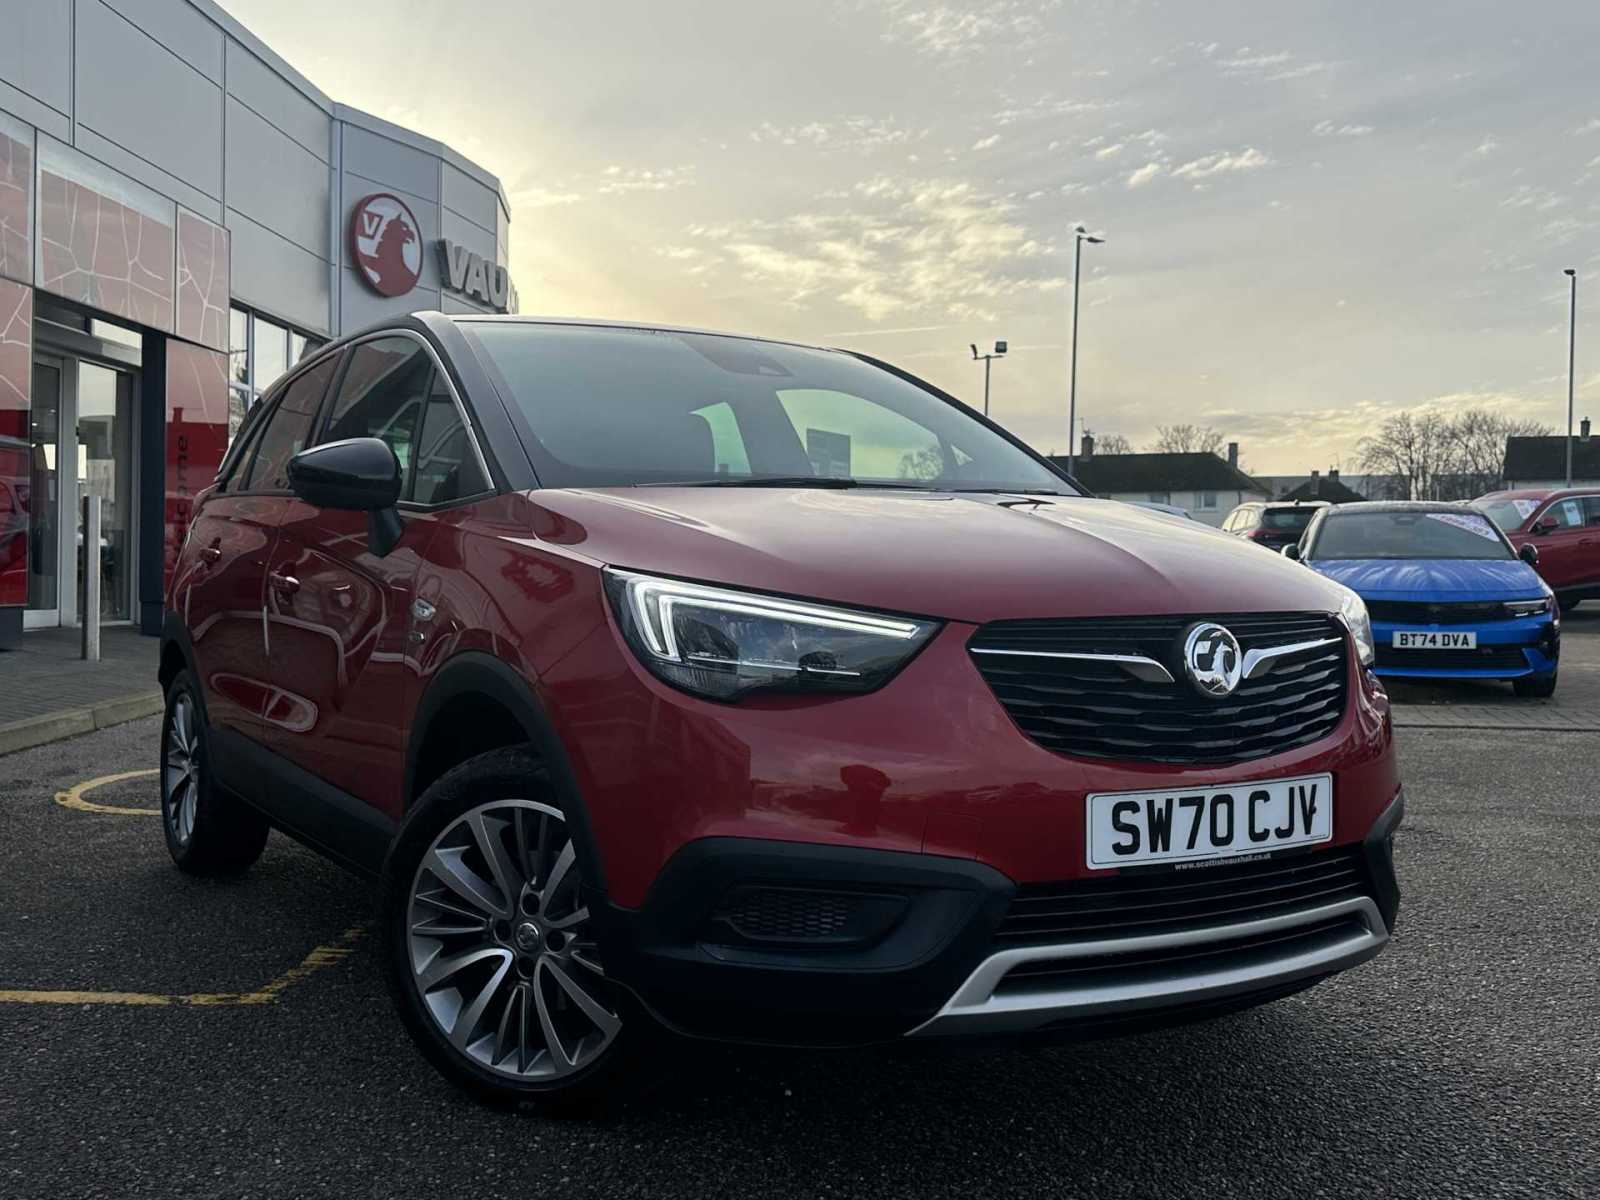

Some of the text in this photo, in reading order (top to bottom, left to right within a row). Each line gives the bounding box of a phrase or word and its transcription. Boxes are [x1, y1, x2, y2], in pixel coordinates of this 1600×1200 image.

[1400, 633, 1469, 647] BT74 DVA
[1111, 783, 1318, 856] SW70 CJV
